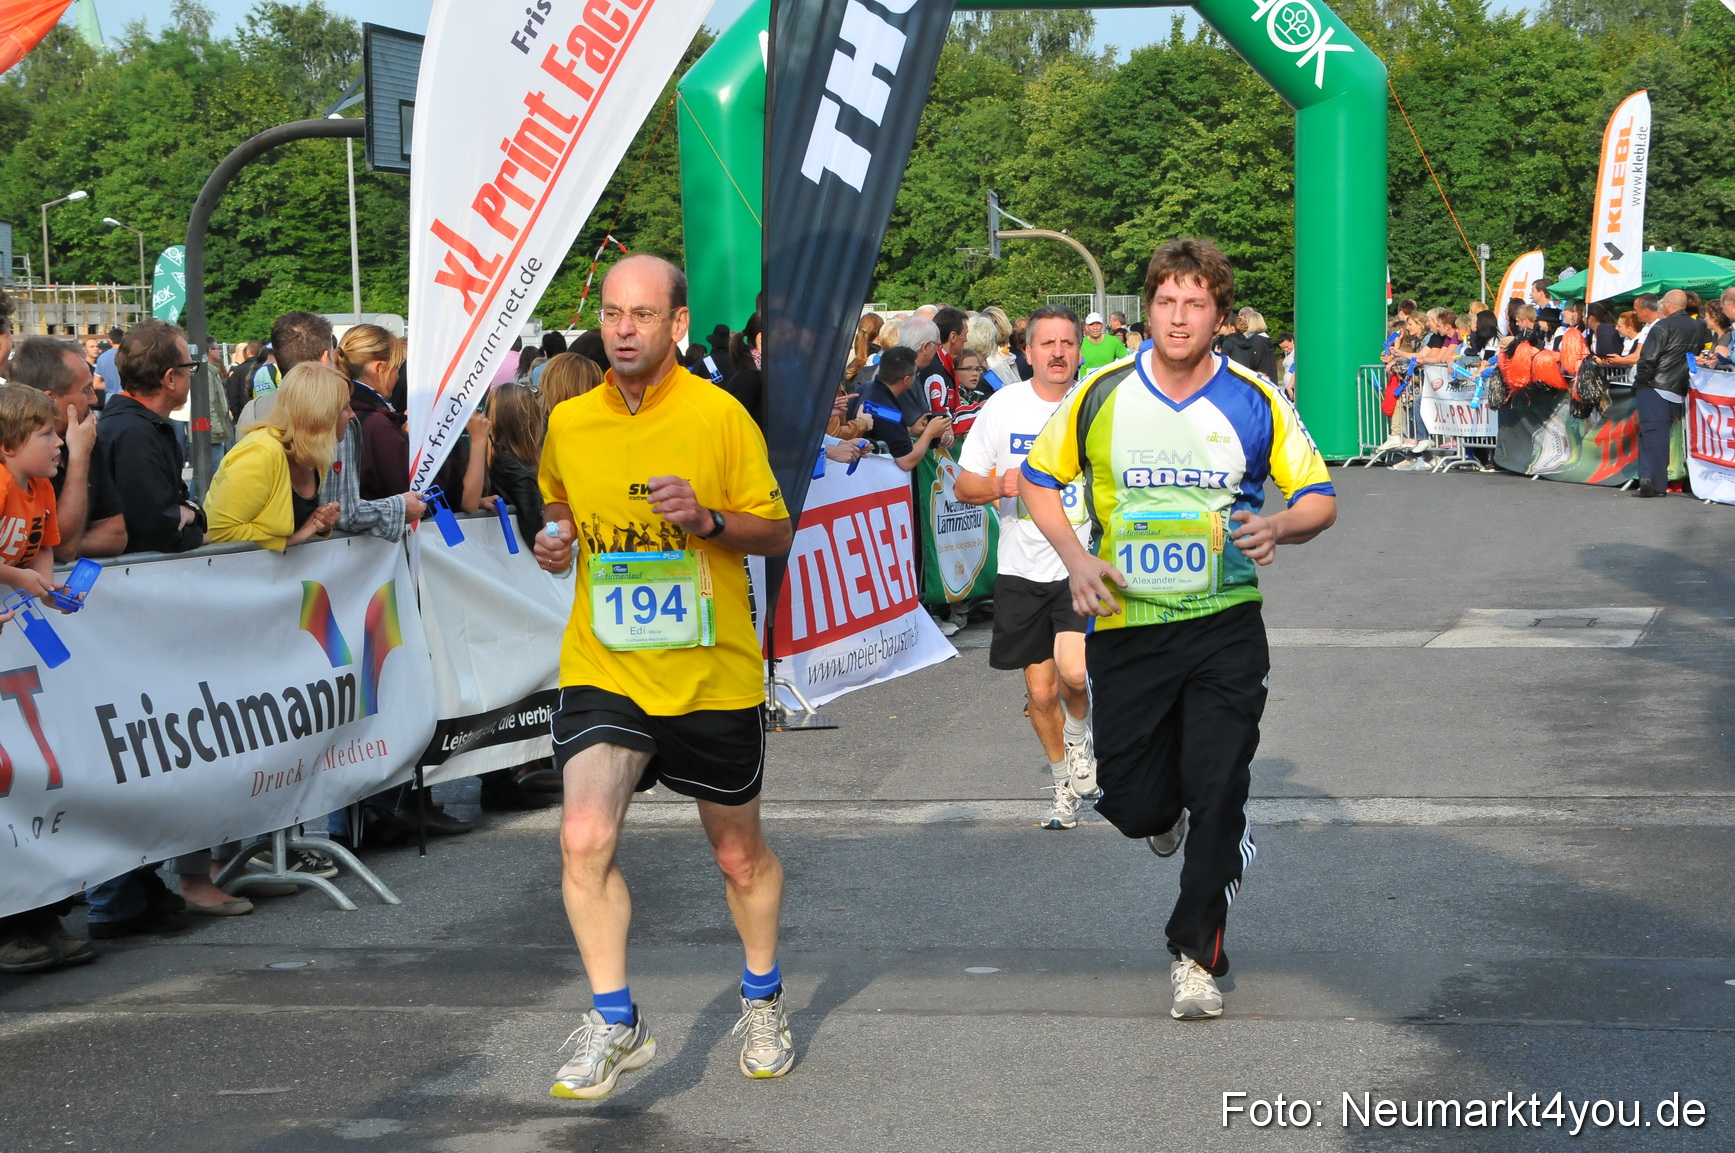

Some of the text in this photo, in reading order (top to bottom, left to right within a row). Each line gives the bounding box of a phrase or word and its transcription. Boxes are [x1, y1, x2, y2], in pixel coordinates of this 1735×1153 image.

[471, 91, 579, 242] Print
[540, 0, 645, 102] Fac
[801, 0, 918, 193] TH
[1607, 116, 1633, 233] KLEBL
[1632, 126, 1648, 207] www.klebl.de
[412, 256, 543, 493] www.frischmann-net.de
[1433, 402, 1500, 425] XL-PRINT
[1695, 398, 1735, 463] ME
[1124, 467, 1229, 489] BOCK
[1127, 450, 1193, 465] TEAM
[788, 501, 918, 641] MEIER
[1118, 542, 1206, 574] 1060
[1132, 577, 1176, 585] Alexander
[605, 584, 688, 625] 194
[630, 626, 646, 636] Edi
[94, 672, 356, 784] Frischmann
[518, 704, 553, 727] verbi
[250, 759, 304, 797] Druck
[323, 739, 388, 771] Medien
